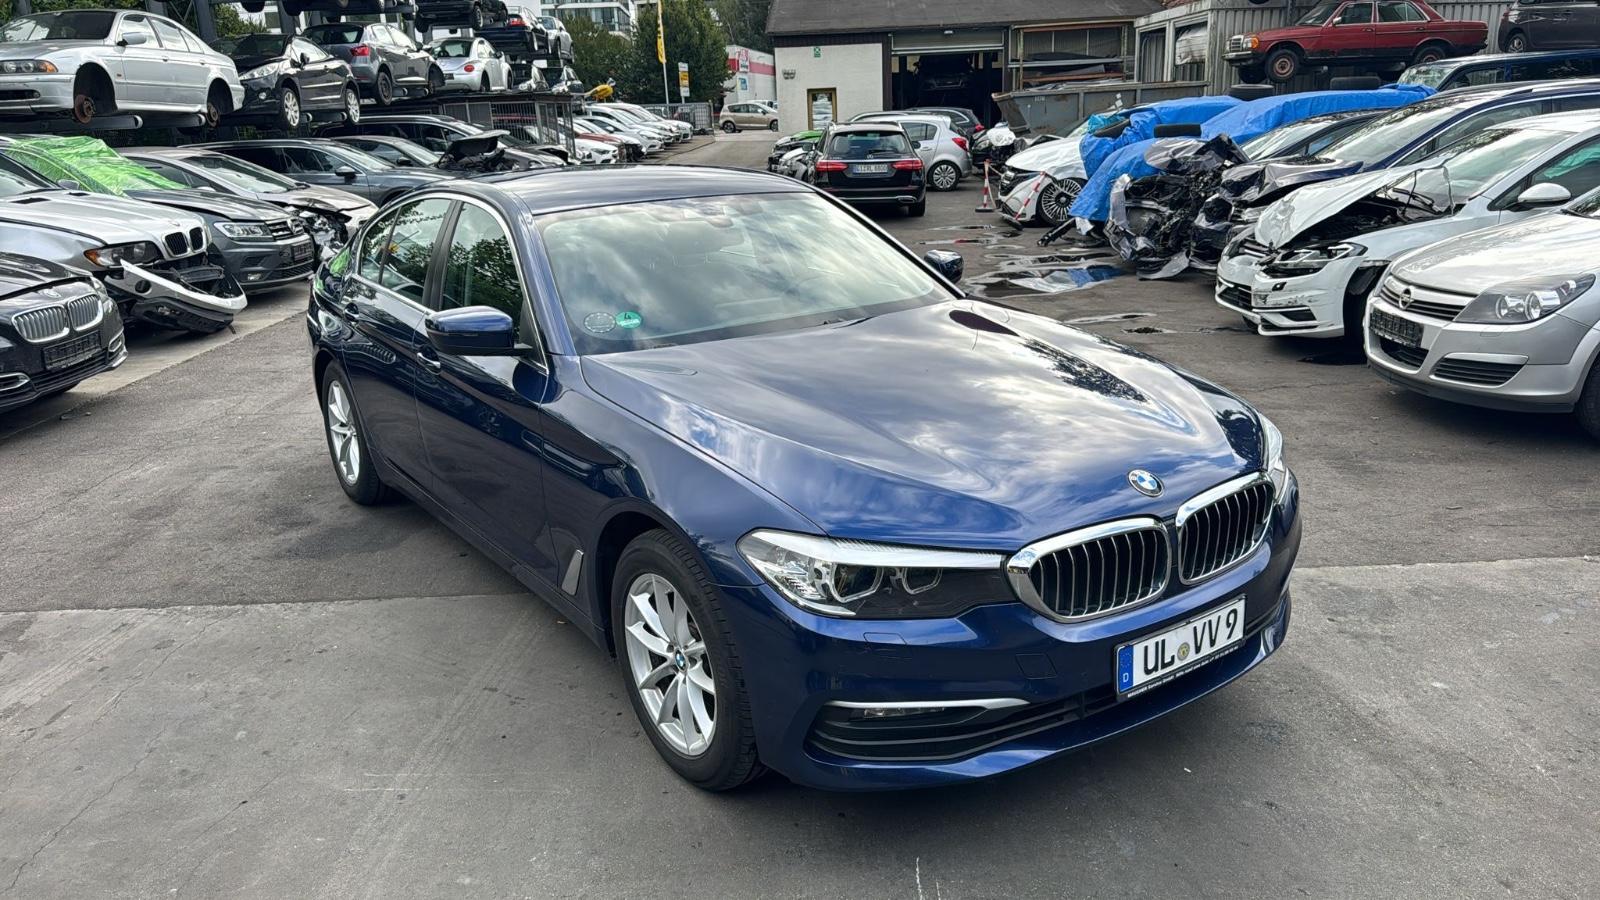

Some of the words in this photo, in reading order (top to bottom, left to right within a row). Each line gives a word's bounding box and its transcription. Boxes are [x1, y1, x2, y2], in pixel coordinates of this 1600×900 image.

[1143, 638, 1176, 676] UL
[1193, 614, 1222, 655] VV
[1226, 608, 1238, 640] 9
[1122, 672, 1130, 683] D
